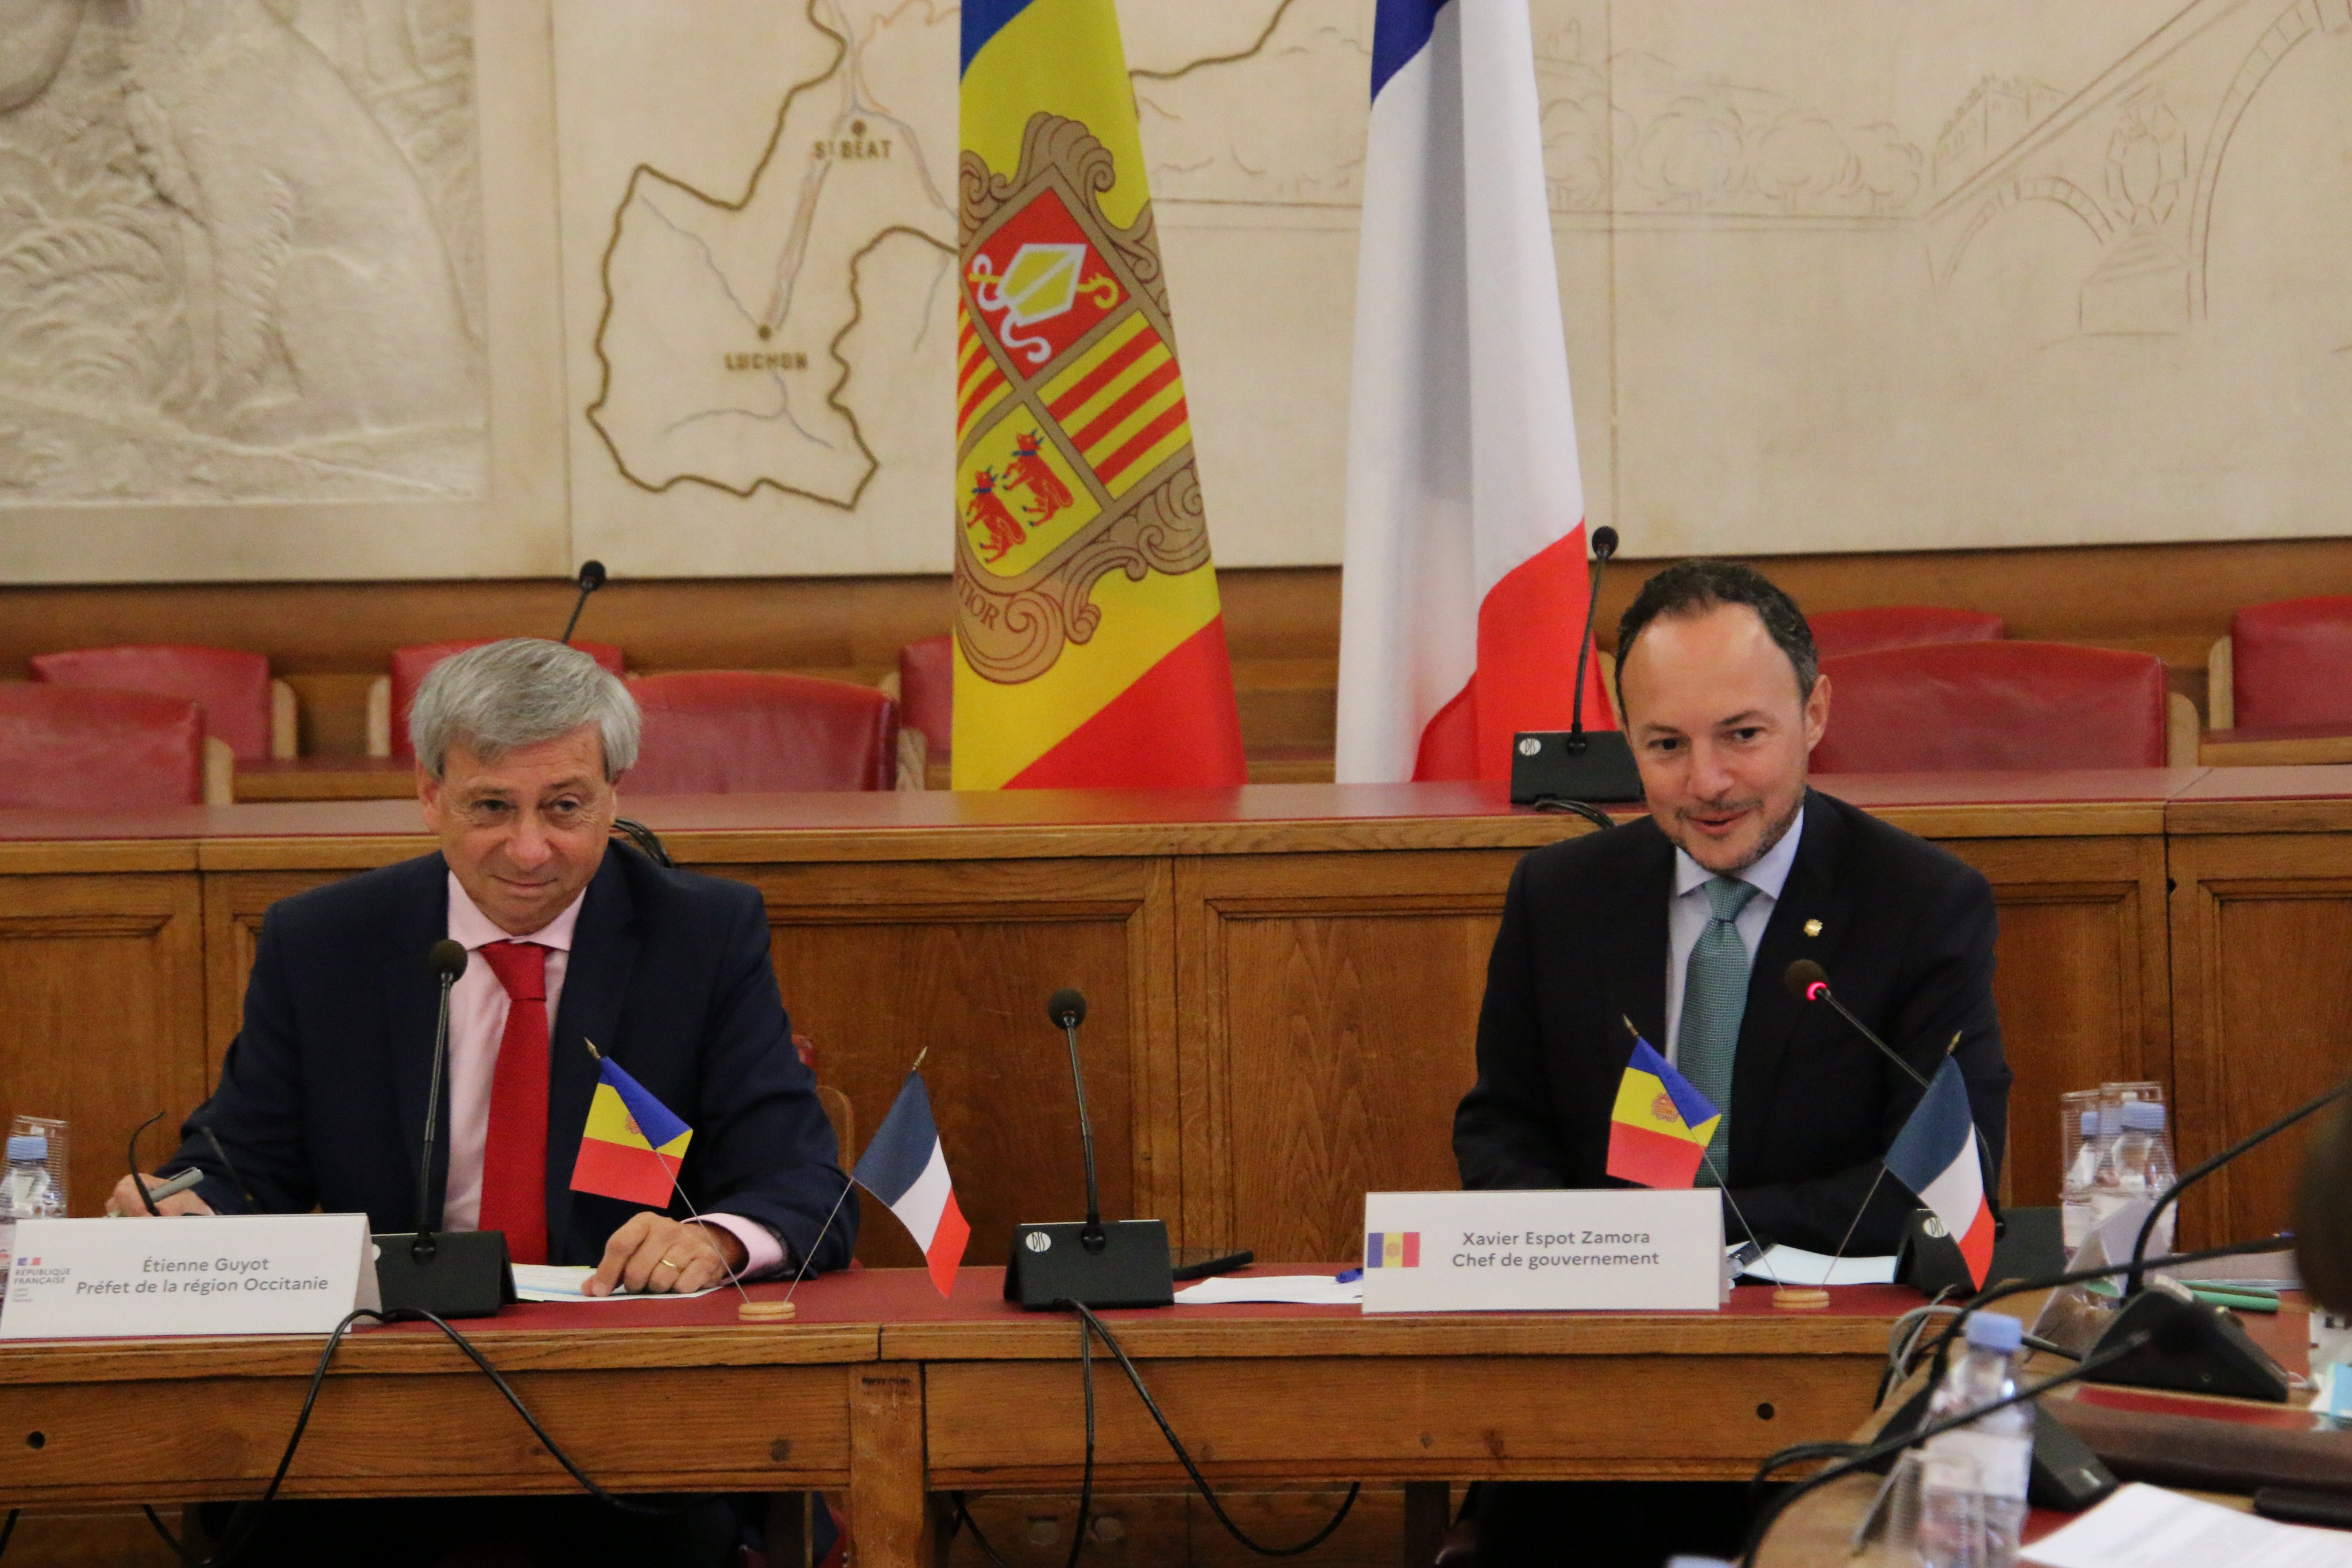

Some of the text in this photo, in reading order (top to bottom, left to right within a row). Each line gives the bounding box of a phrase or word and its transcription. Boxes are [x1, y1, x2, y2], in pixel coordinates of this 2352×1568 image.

[1463, 1230, 1650, 1248] Xavier Espot Zamora
[142, 1256, 269, 1274] Étienne Guyot
[1452, 1252, 1659, 1270] Chef de gouvernement
[76, 1276, 328, 1296] Préfet de la région Occitanie
